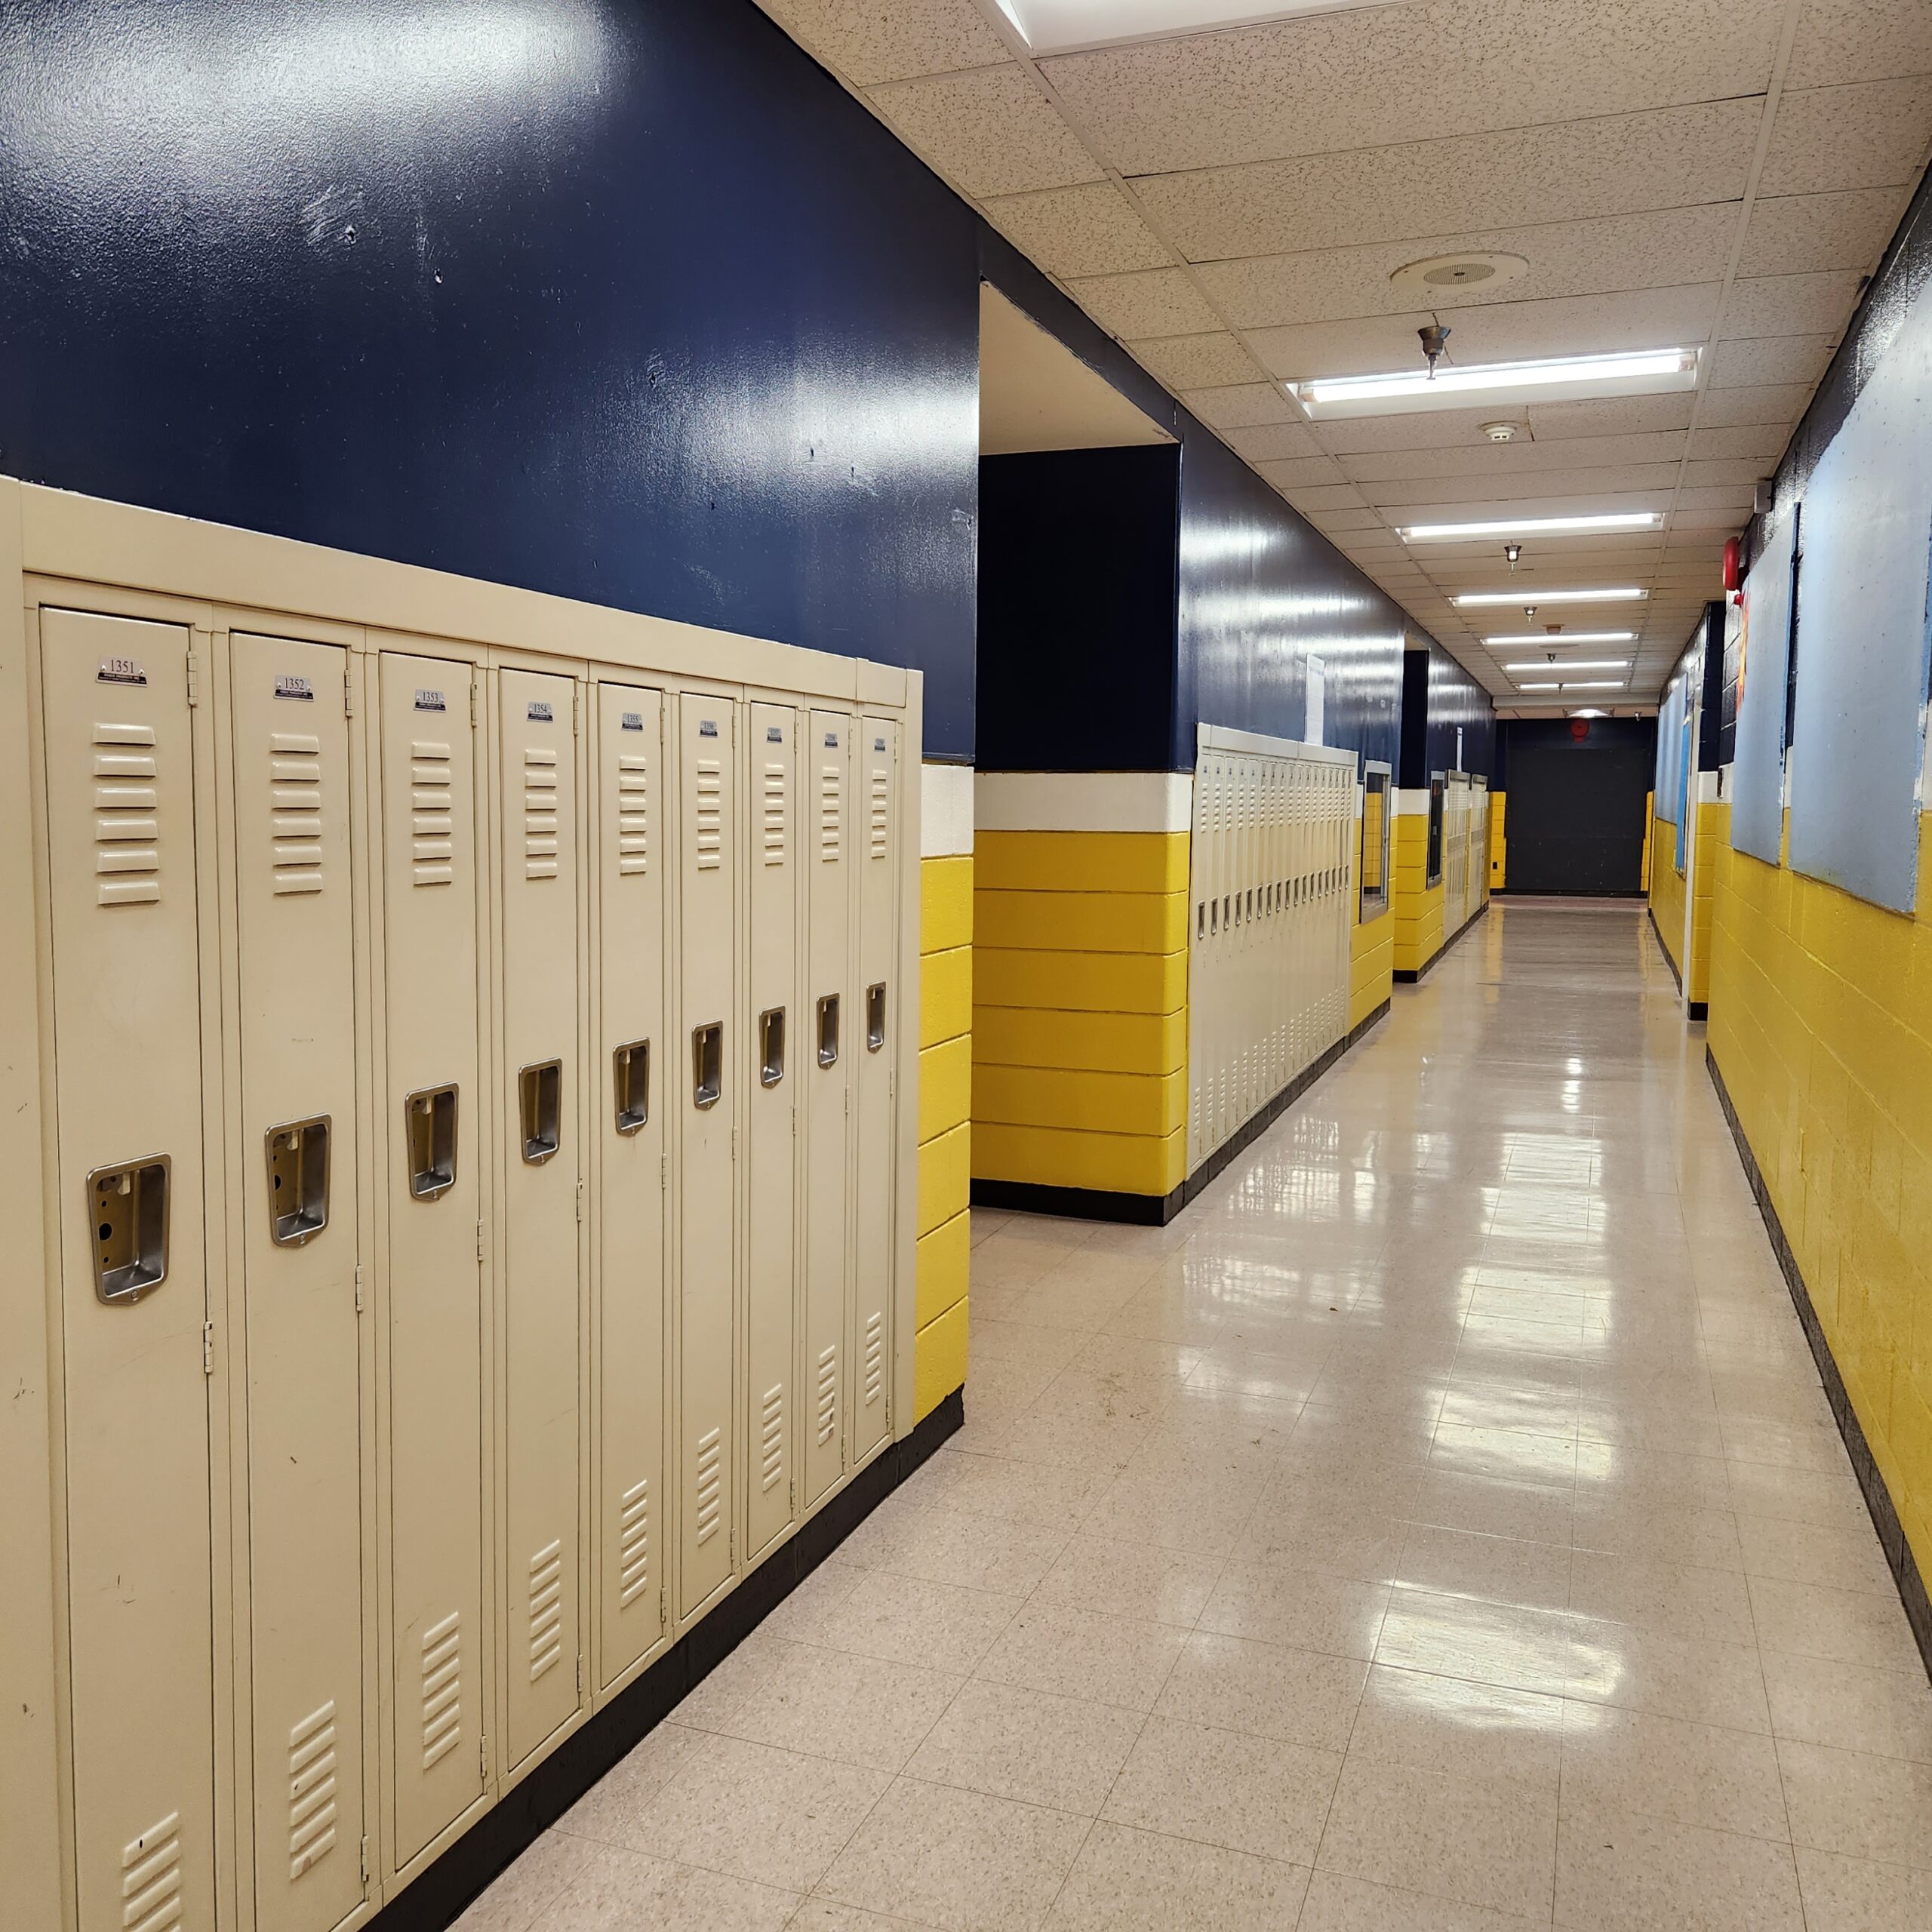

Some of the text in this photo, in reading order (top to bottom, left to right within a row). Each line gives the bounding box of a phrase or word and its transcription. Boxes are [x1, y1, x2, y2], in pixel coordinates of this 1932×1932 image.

[111, 659, 134, 674] 1351
[285, 678, 305, 691] 1352
[423, 691, 438, 703] 1353
[534, 703, 547, 714] 1354
